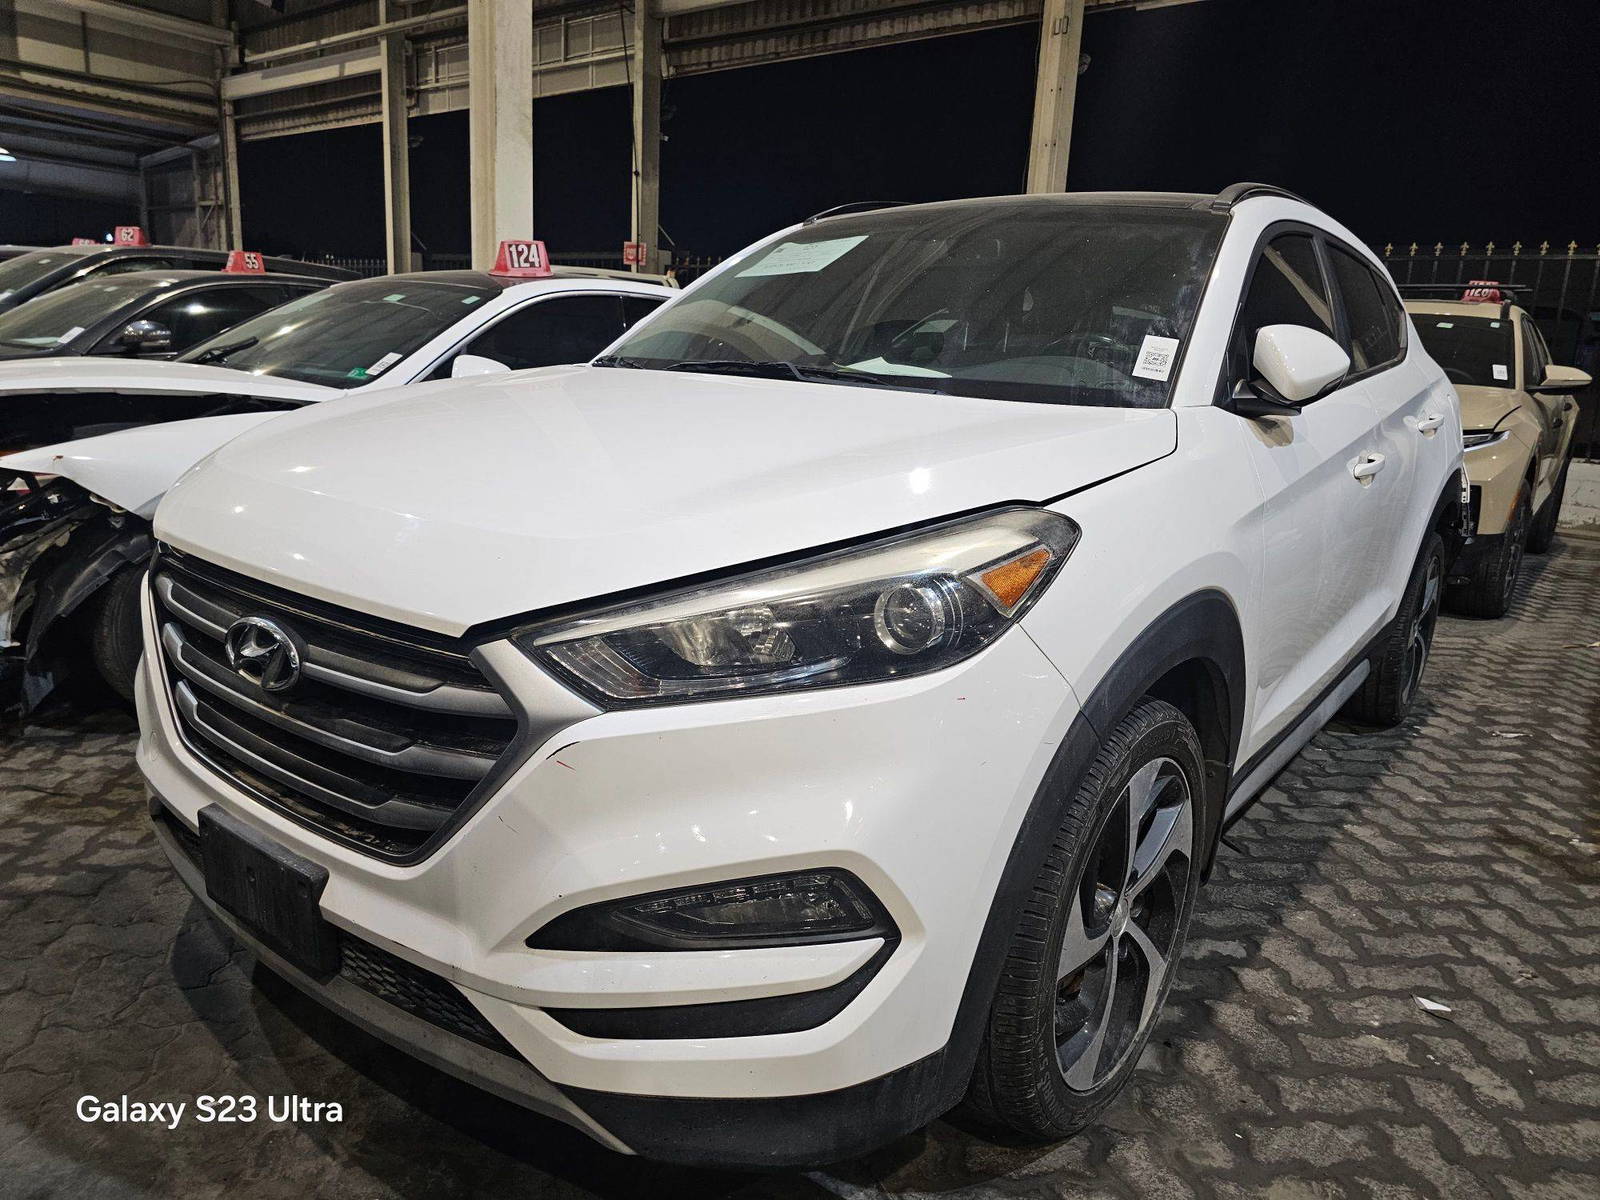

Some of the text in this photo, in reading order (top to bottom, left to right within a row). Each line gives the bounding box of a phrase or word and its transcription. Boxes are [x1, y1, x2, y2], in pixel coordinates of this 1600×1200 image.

[121, 229, 134, 242] 62
[244, 253, 259, 269] 55
[509, 244, 540, 268] 124
